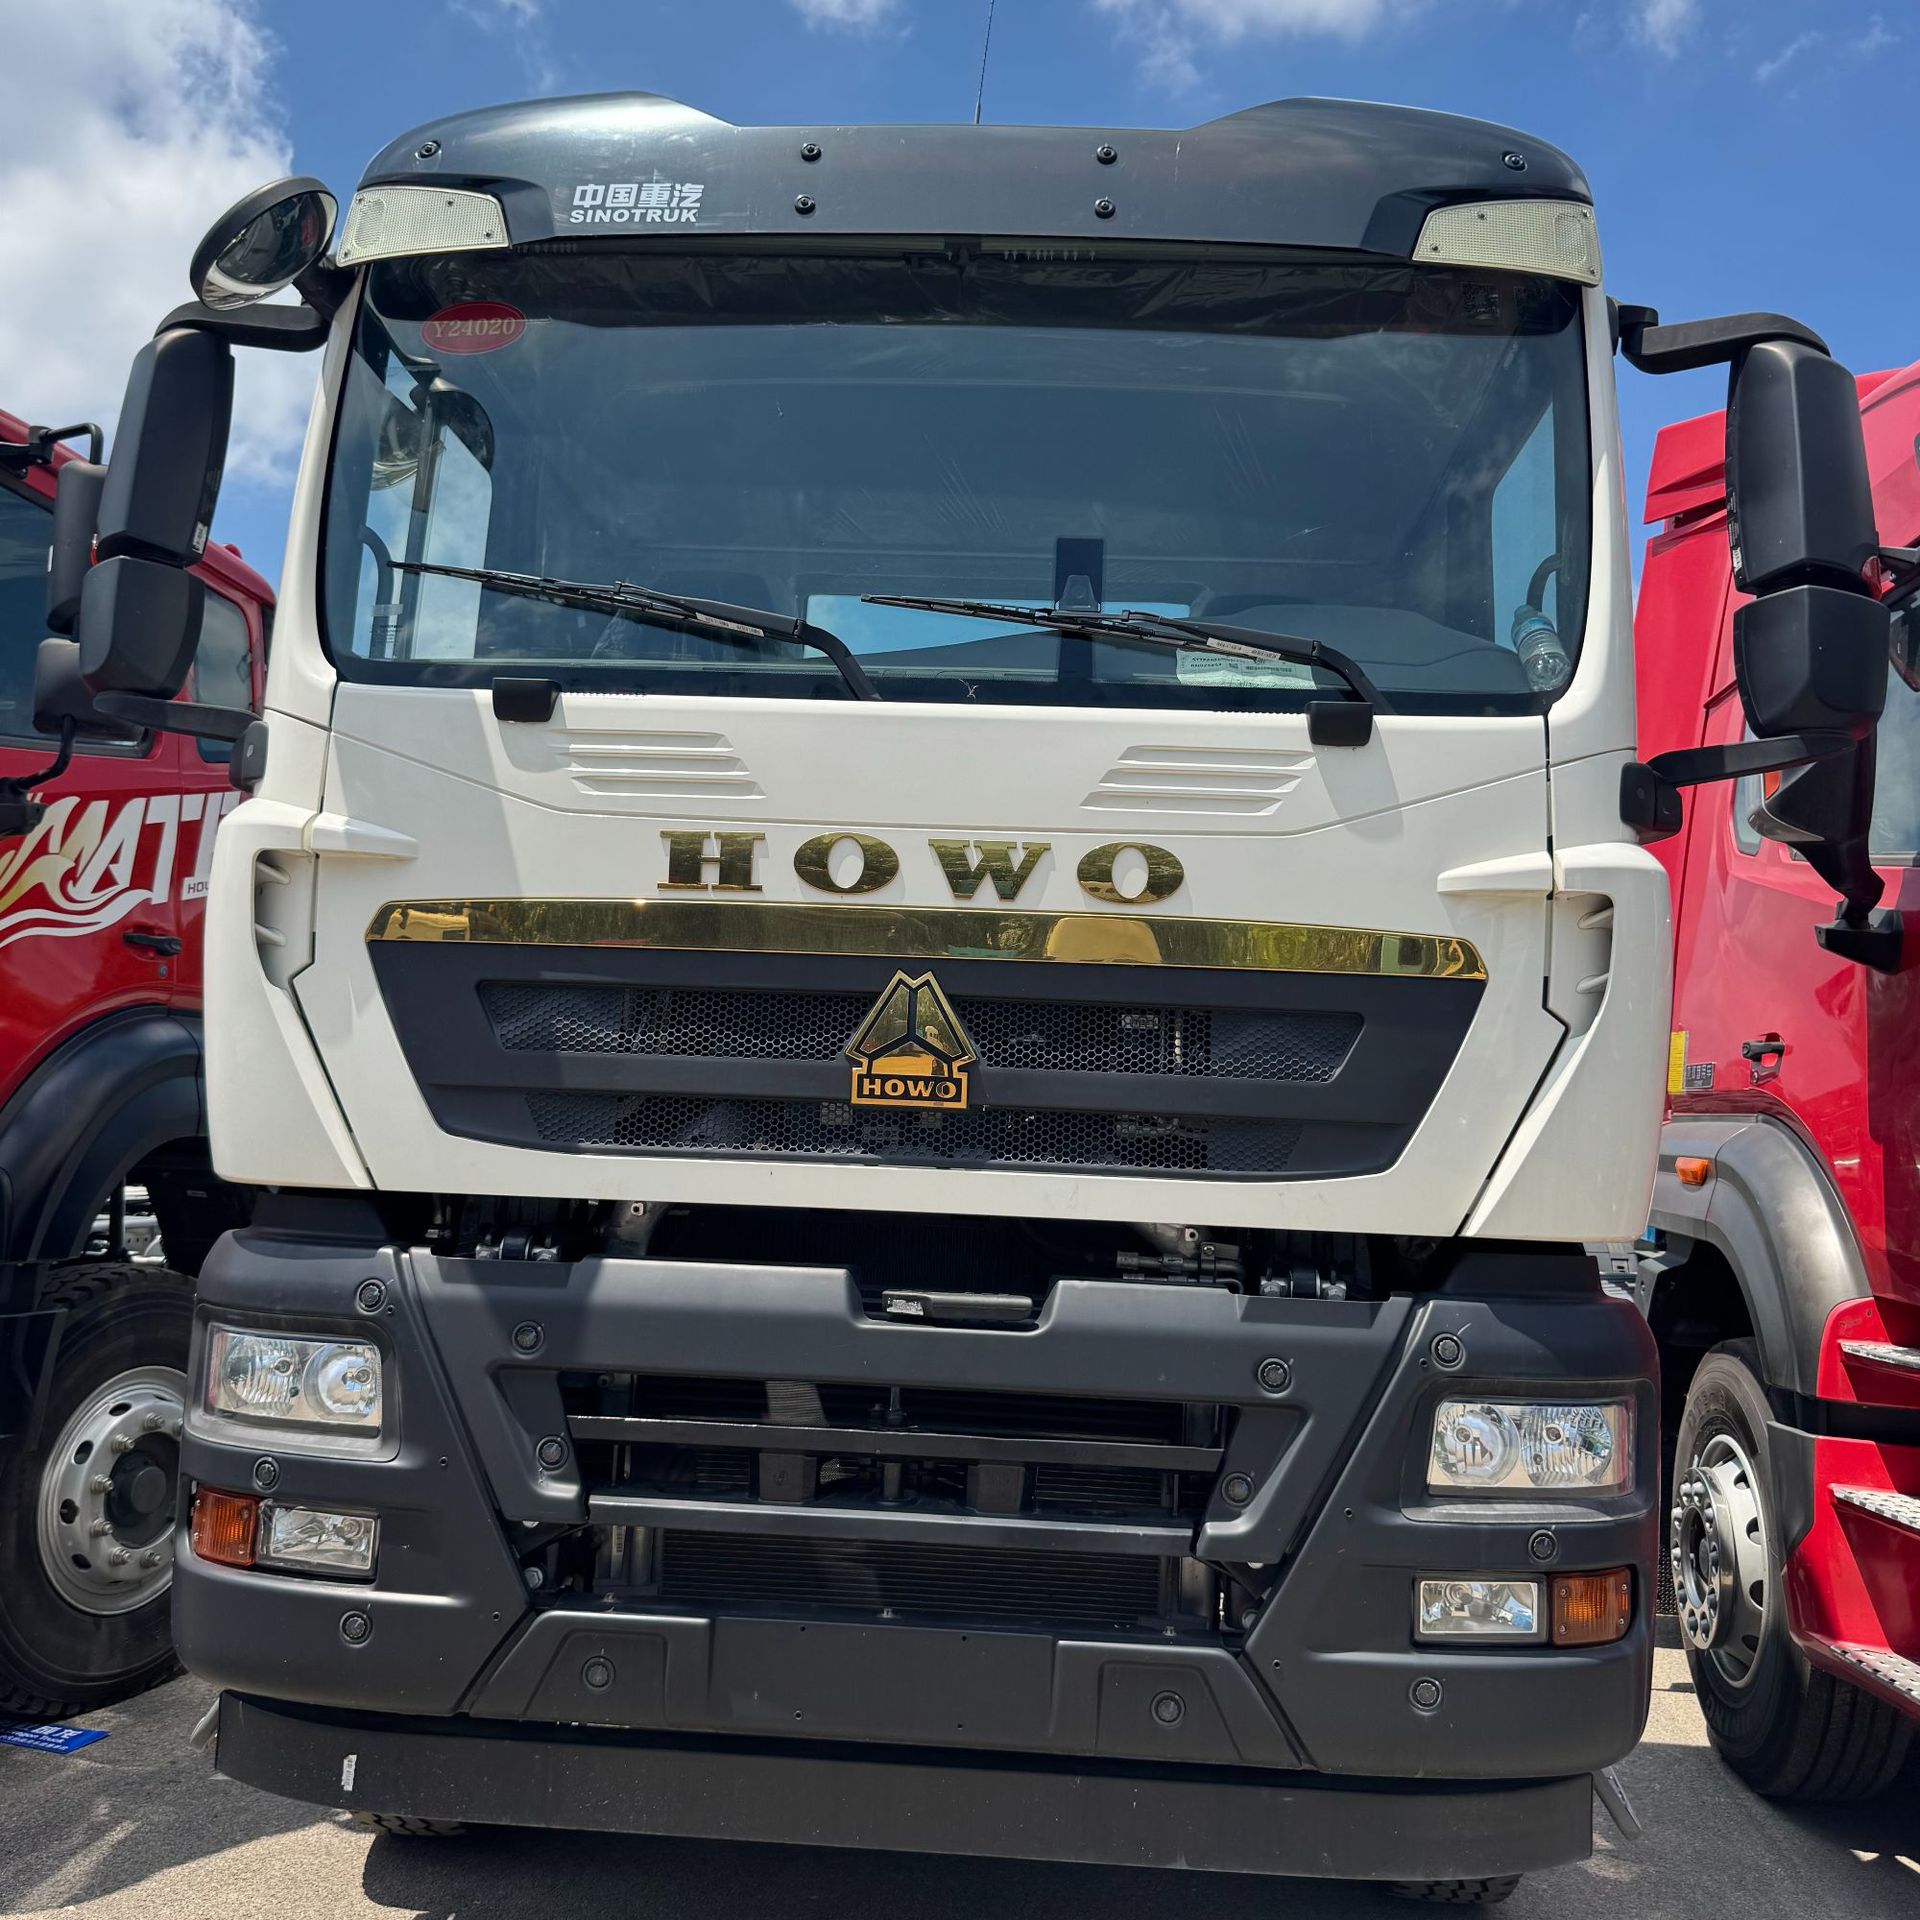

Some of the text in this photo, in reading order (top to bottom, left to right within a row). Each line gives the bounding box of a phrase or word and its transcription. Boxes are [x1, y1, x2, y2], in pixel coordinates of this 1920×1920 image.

[572, 183, 704, 208] 中国重汽
[569, 208, 699, 223] SINOTRUK
[432, 317, 517, 338] Y24020
[657, 830, 1185, 904] HOWO
[862, 1079, 957, 1099] HOWO
